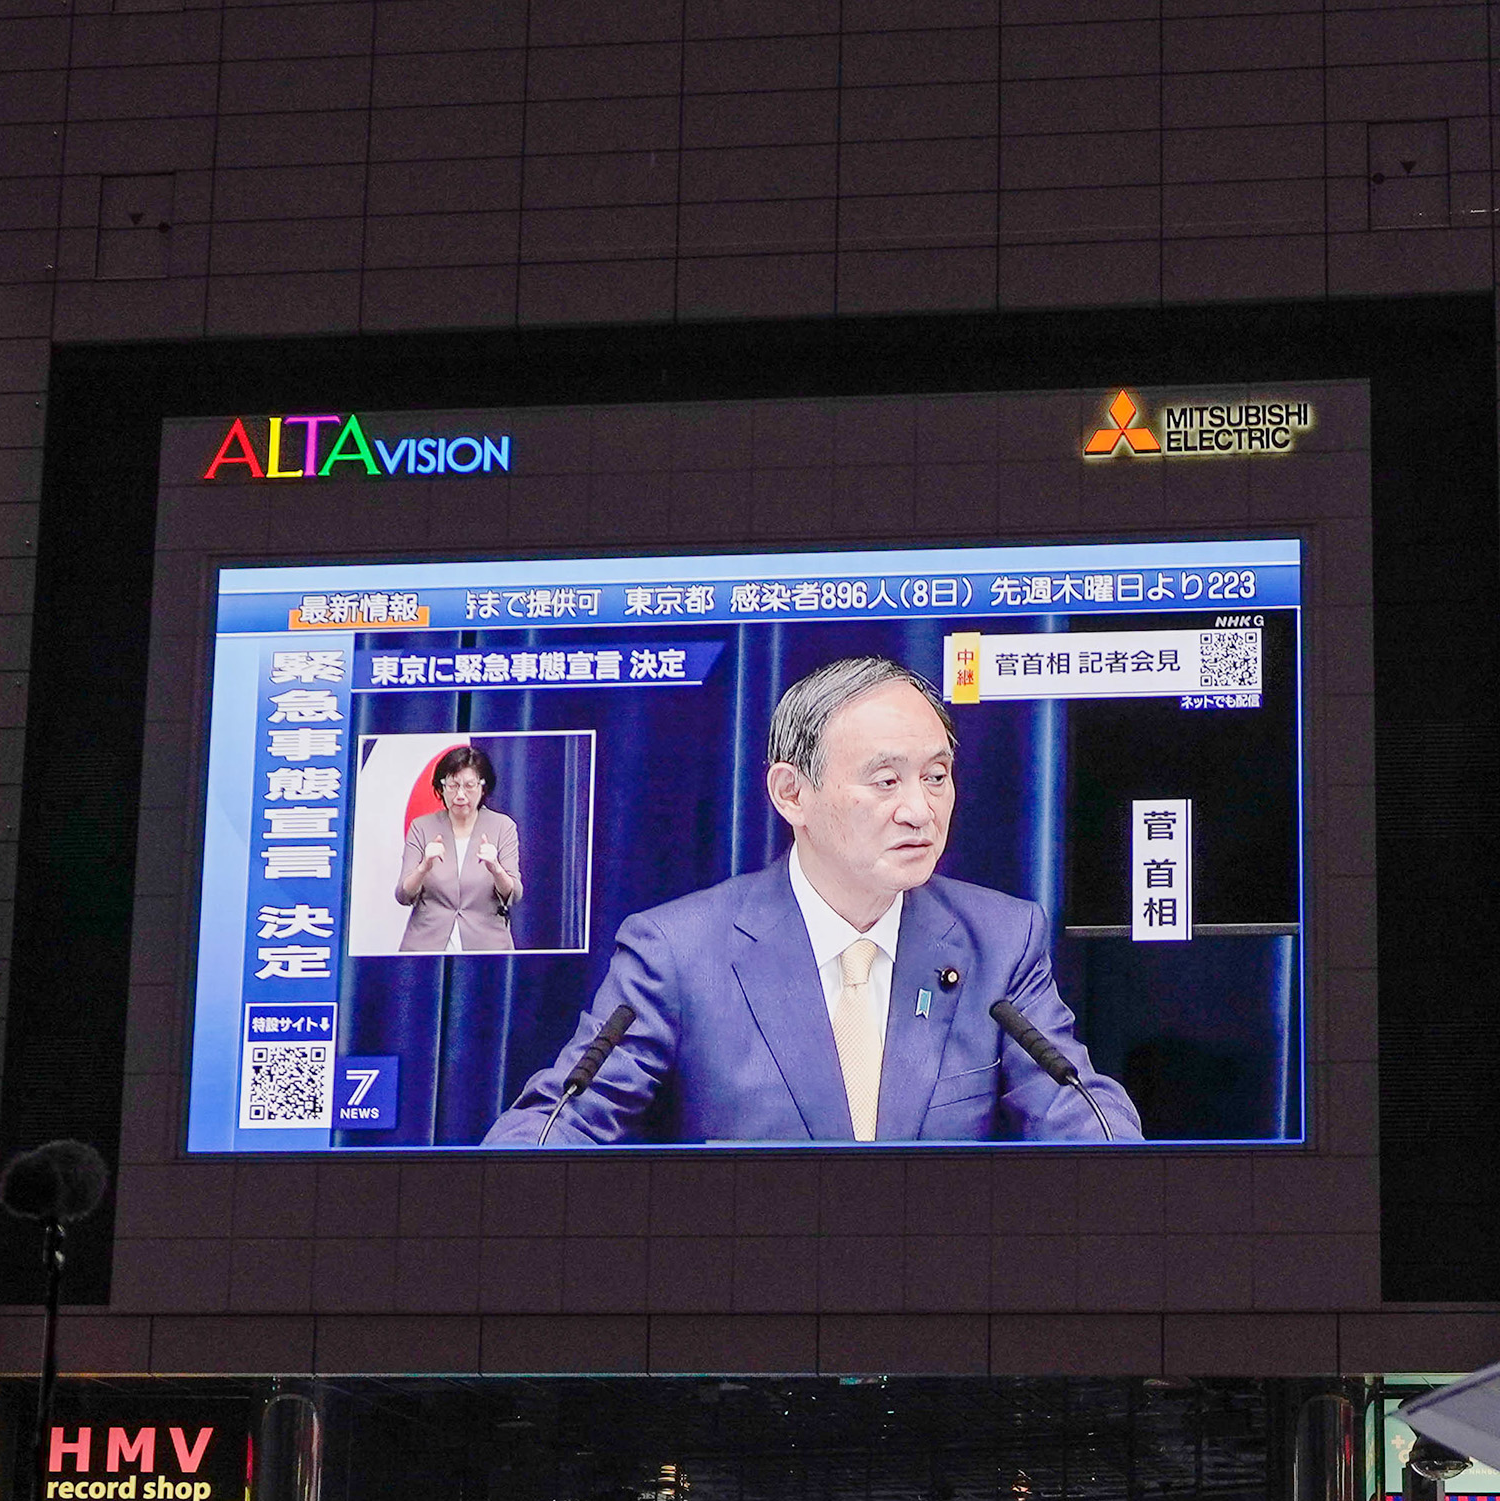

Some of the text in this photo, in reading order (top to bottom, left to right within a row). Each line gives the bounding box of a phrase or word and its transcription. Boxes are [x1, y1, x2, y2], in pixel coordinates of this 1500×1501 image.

[1166, 403, 1309, 429] MITSUBISHI
[1166, 427, 1291, 452] ELECTRIC
[299, 592, 419, 624] 最新情報
[623, 584, 714, 615] 東京都
[989, 570, 1257, 606] 先週木曜日より223
[1214, 615, 1250, 628] NHK
[371, 648, 688, 685] 東京に緊急事態宣言 決定
[956, 648, 975, 688] 中継
[995, 648, 1182, 678] 菅首相 記者会見
[1181, 694, 1262, 709] ネットでも配信
[254, 648, 346, 980] 緊急事態宣言 決定
[1142, 810, 1178, 928] 菅首相
[250, 1015, 319, 1035] 特設サイト
[344, 1068, 382, 1107] 7
[339, 1108, 381, 1121] NEWS
[47, 1426, 214, 1474] HMV
[46, 1474, 137, 1500] record
